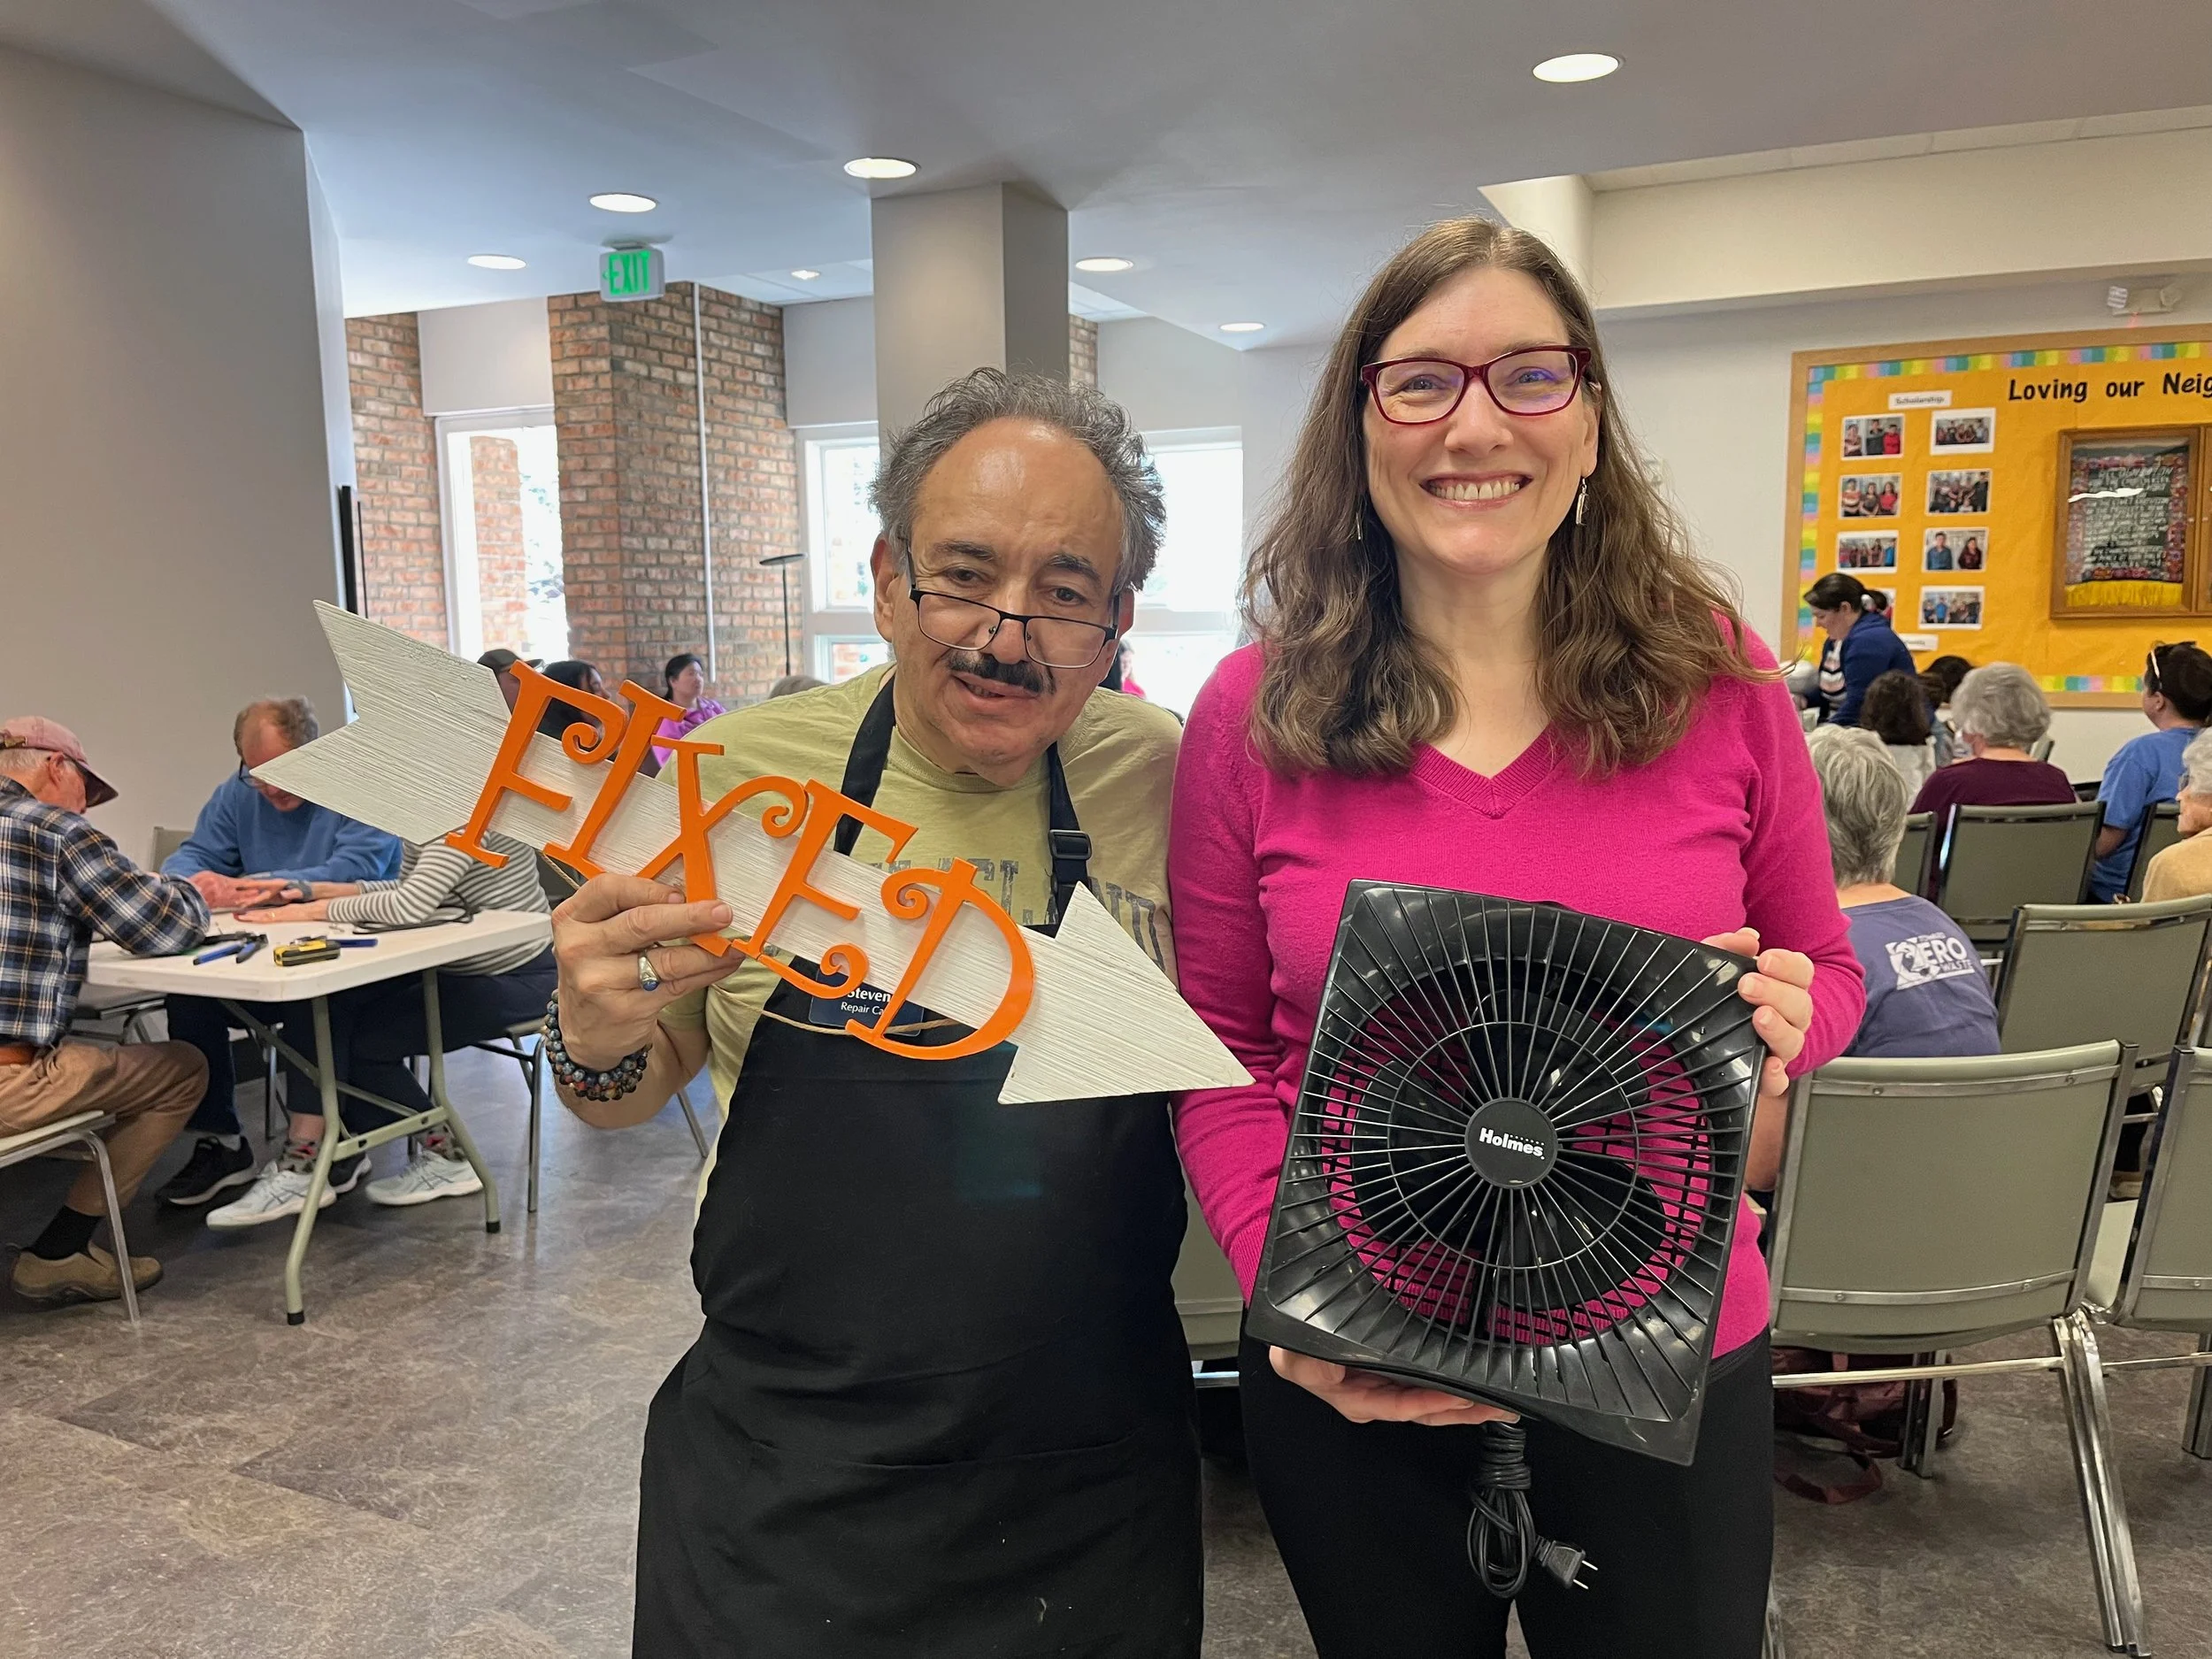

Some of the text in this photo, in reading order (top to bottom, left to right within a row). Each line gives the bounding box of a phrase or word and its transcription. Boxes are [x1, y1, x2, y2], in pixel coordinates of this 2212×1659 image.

[608, 250, 650, 296] EXIT
[2008, 379, 2088, 403] Loving
[2106, 380, 2145, 397] our
[444, 659, 1036, 1060] FIXED
[847, 987, 891, 1003] Steven
[841, 1002, 885, 1016] Repair Ca
[1479, 1127, 1544, 1157] Holmes
